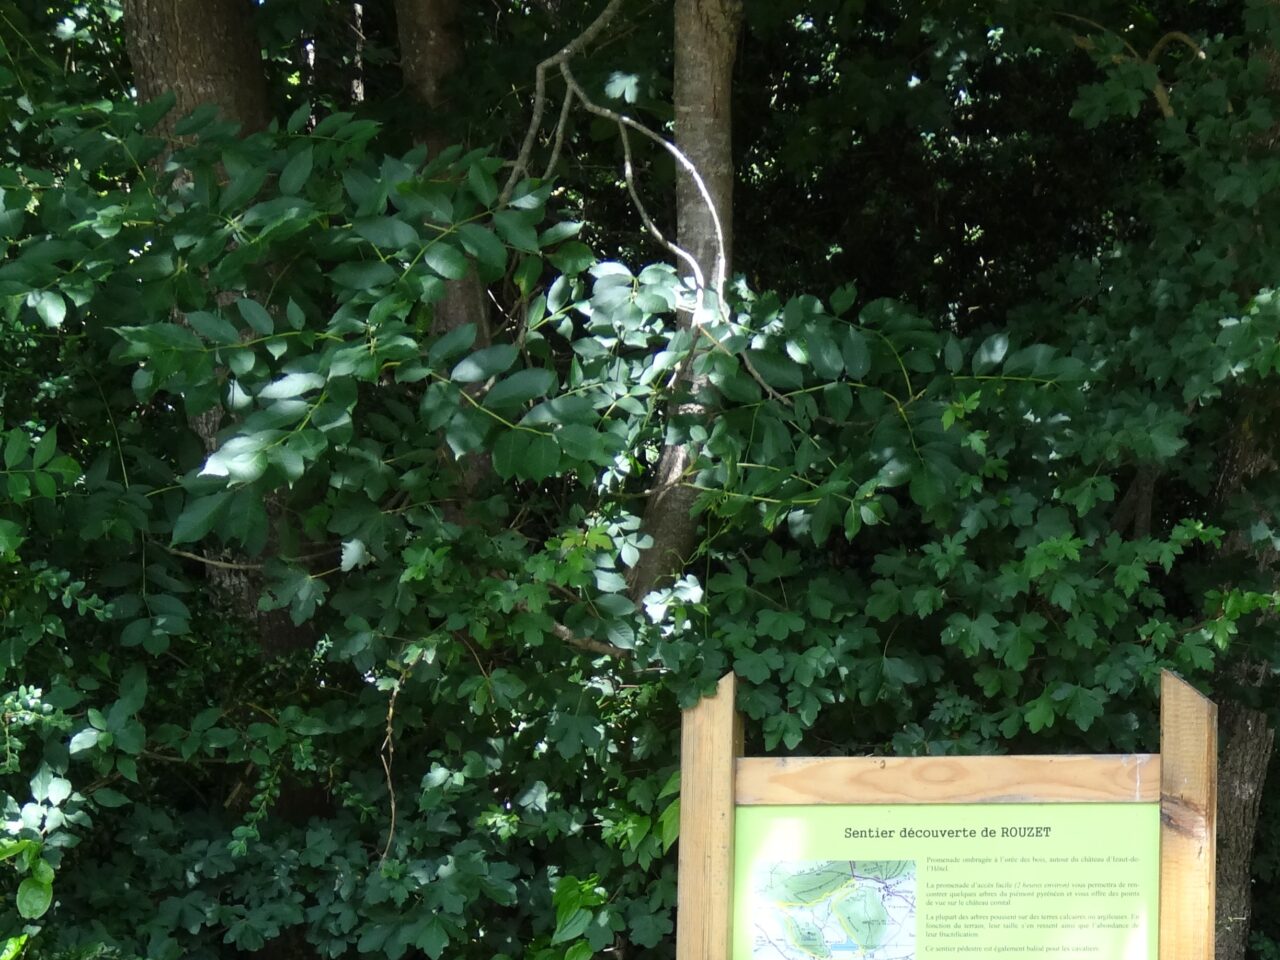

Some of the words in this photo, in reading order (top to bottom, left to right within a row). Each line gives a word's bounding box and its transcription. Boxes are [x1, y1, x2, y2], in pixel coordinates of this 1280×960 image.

[844, 827, 895, 838] Sentier
[899, 827, 976, 838] découverte
[981, 827, 996, 838] de
[1001, 827, 1051, 838] ROUZET
[936, 882, 969, 890] promenade
